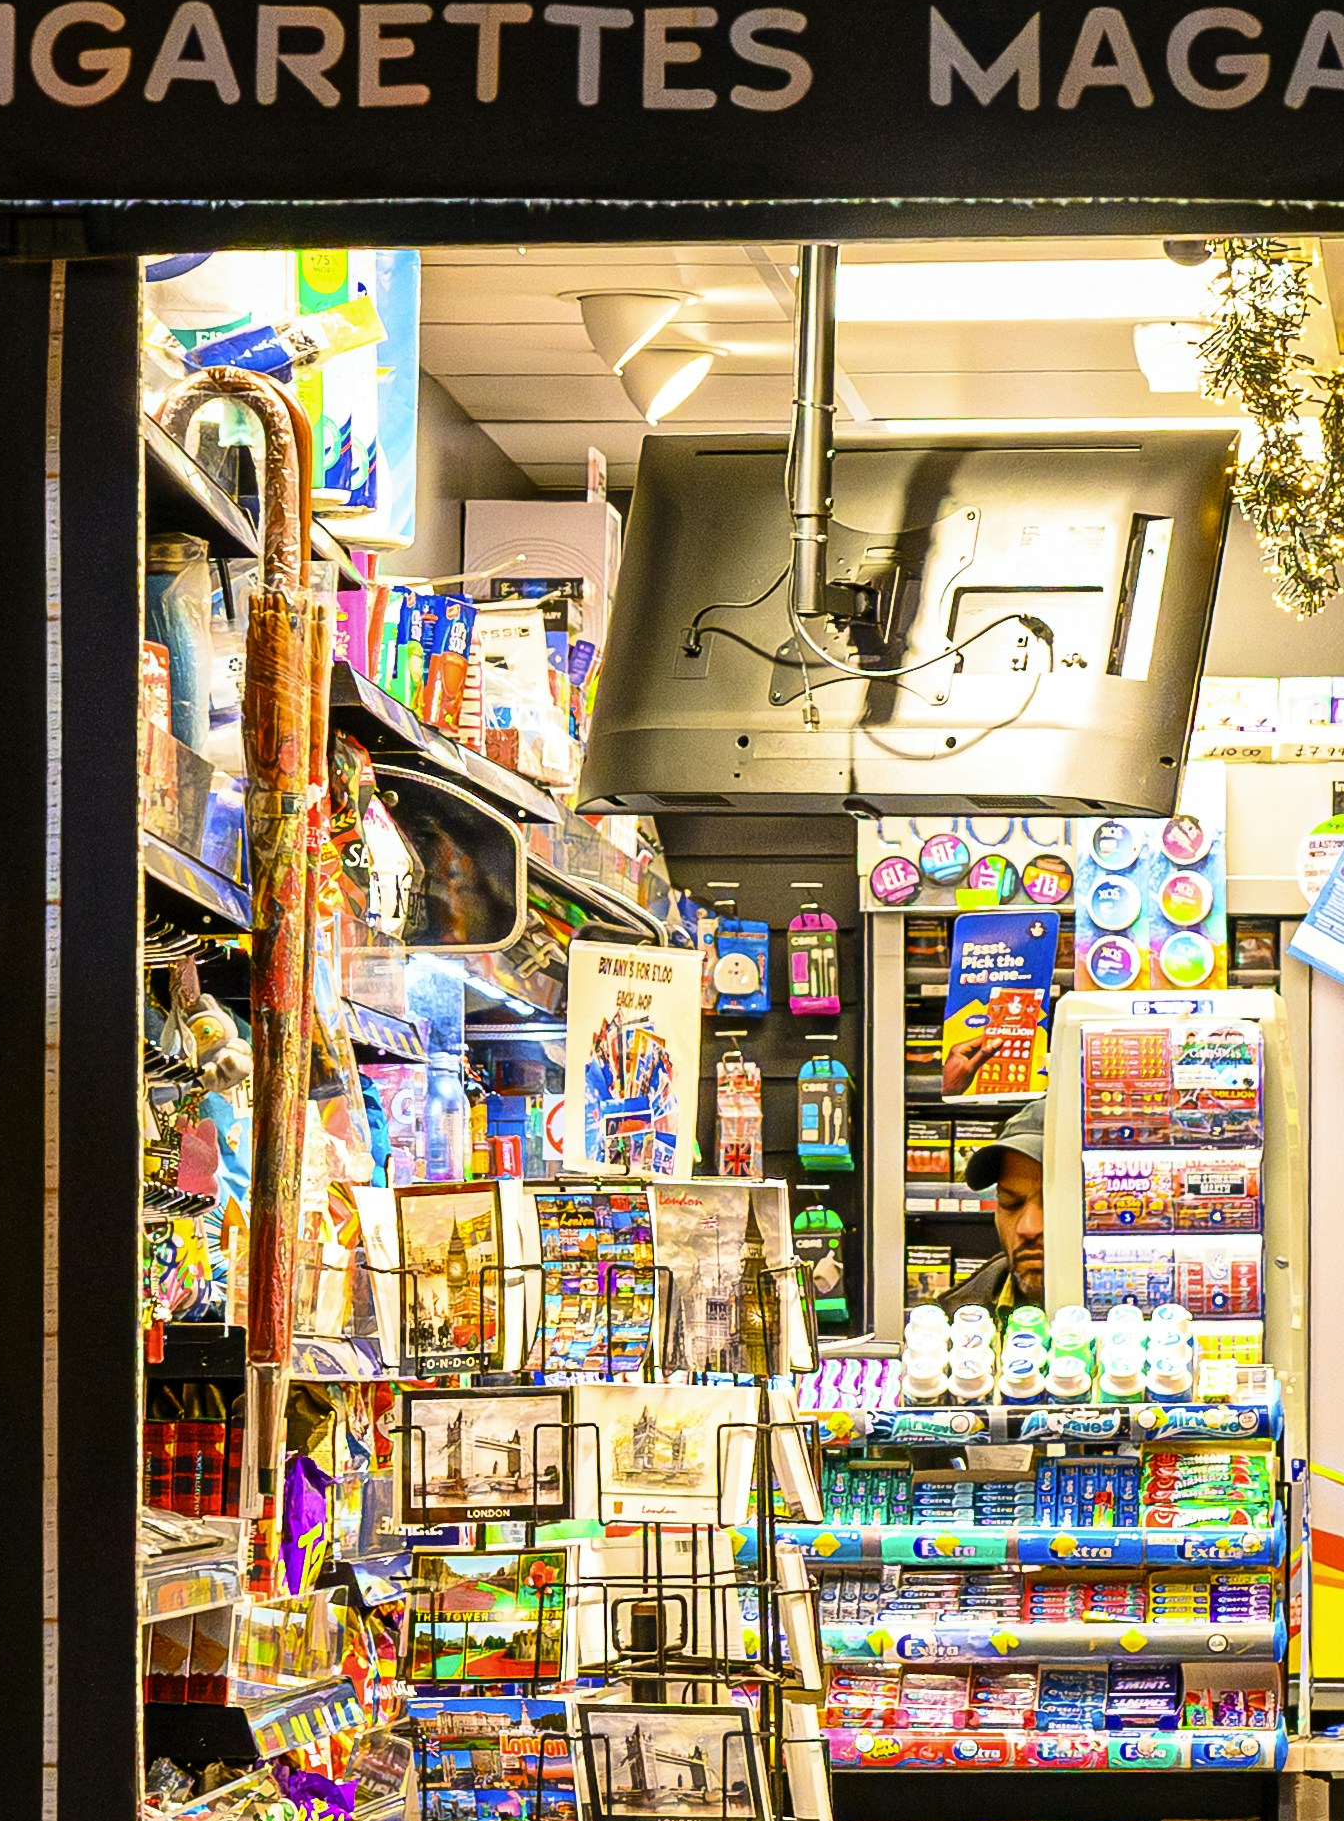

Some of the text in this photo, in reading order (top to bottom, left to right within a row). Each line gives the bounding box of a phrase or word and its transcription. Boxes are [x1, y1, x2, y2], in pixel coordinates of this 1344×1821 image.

[612, 958, 628, 976] ANY
[635, 961, 651, 981] FOR
[961, 954, 1025, 970] Pick the
[959, 970, 989, 985] red
[657, 1190, 704, 1208] London
[559, 1211, 595, 1228] London
[466, 1508, 512, 1520] LONDON
[445, 1612, 488, 1622] TOWER
[903, 1638, 960, 1657] Extra
